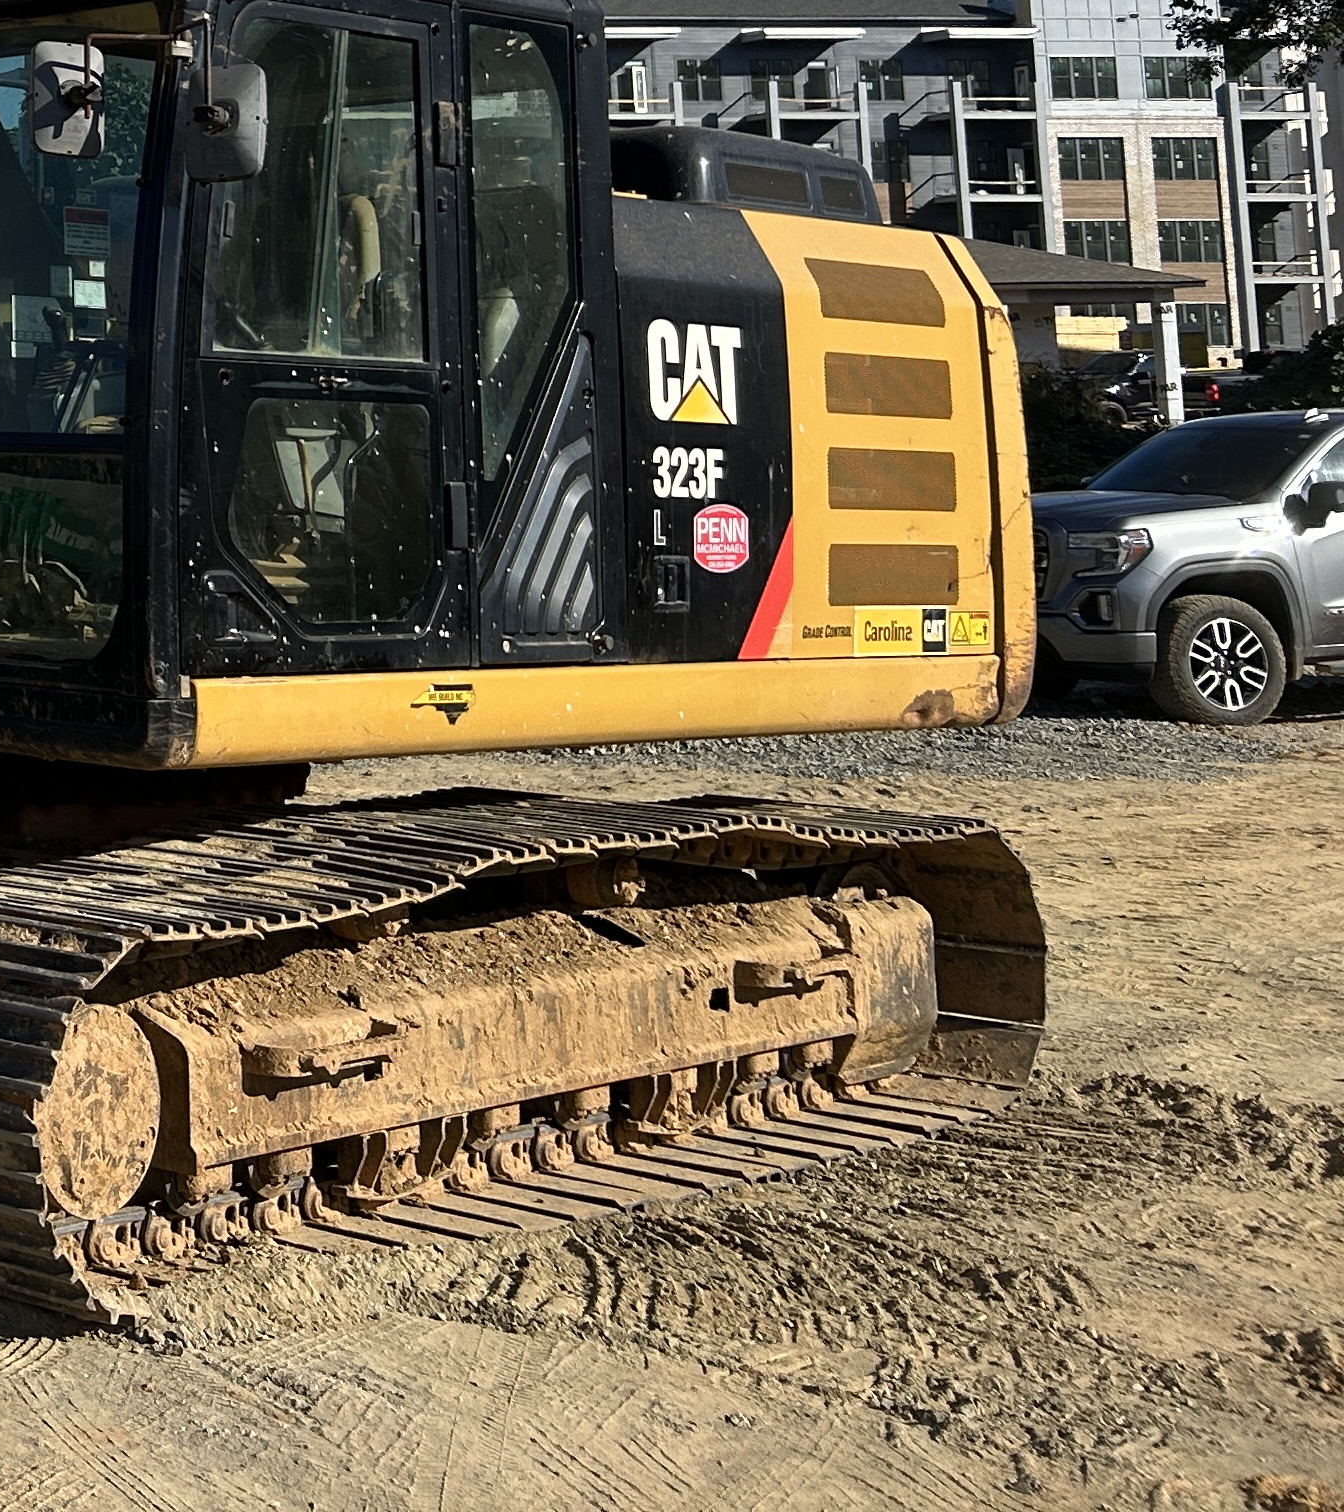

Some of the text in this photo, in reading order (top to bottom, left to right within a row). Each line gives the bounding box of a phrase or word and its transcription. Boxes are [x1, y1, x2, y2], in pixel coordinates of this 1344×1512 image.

[647, 318, 742, 425] CAT
[652, 445, 724, 500] 323F
[653, 508, 666, 546] L
[697, 517, 745, 543] PENN
[864, 619, 946, 643] Carolina CAT
